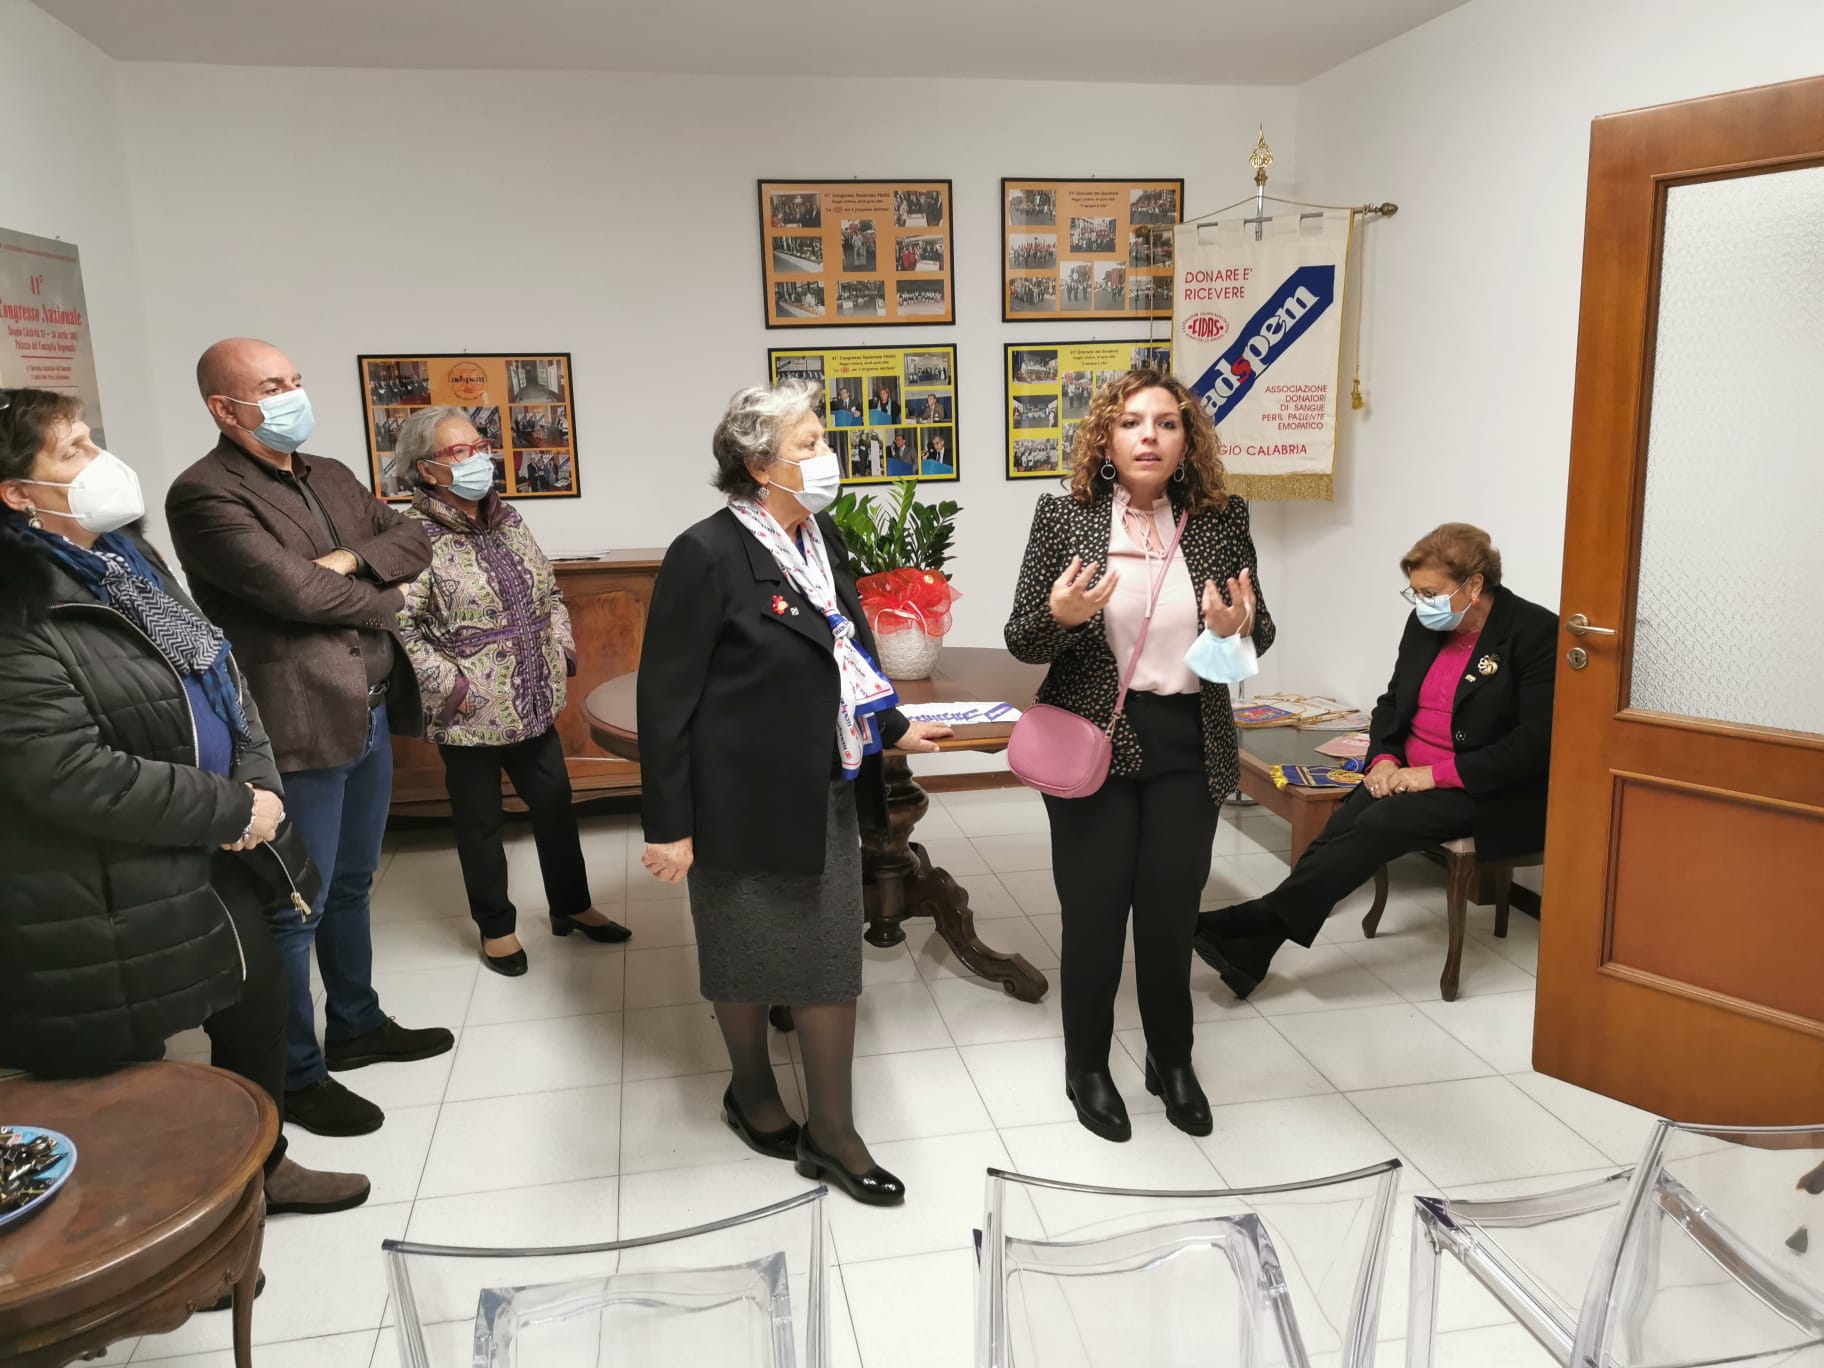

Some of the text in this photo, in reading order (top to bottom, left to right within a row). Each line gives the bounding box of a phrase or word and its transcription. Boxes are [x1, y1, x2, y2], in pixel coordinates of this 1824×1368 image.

[1185, 268, 1240, 284] DONARE
[1184, 286, 1245, 301] RICEVERE
[42, 303, 82, 326] Nazionale
[1200, 285, 1320, 417] adspem
[1265, 384, 1328, 393] ASSOCIAZIONE
[1285, 394, 1326, 403] DONATORI
[1280, 403, 1326, 412] DI SANGUE
[1288, 413, 1326, 421] PAZIENTE
[1278, 422, 1324, 431] EMOPATICO
[1246, 444, 1307, 456] CALABRIA
